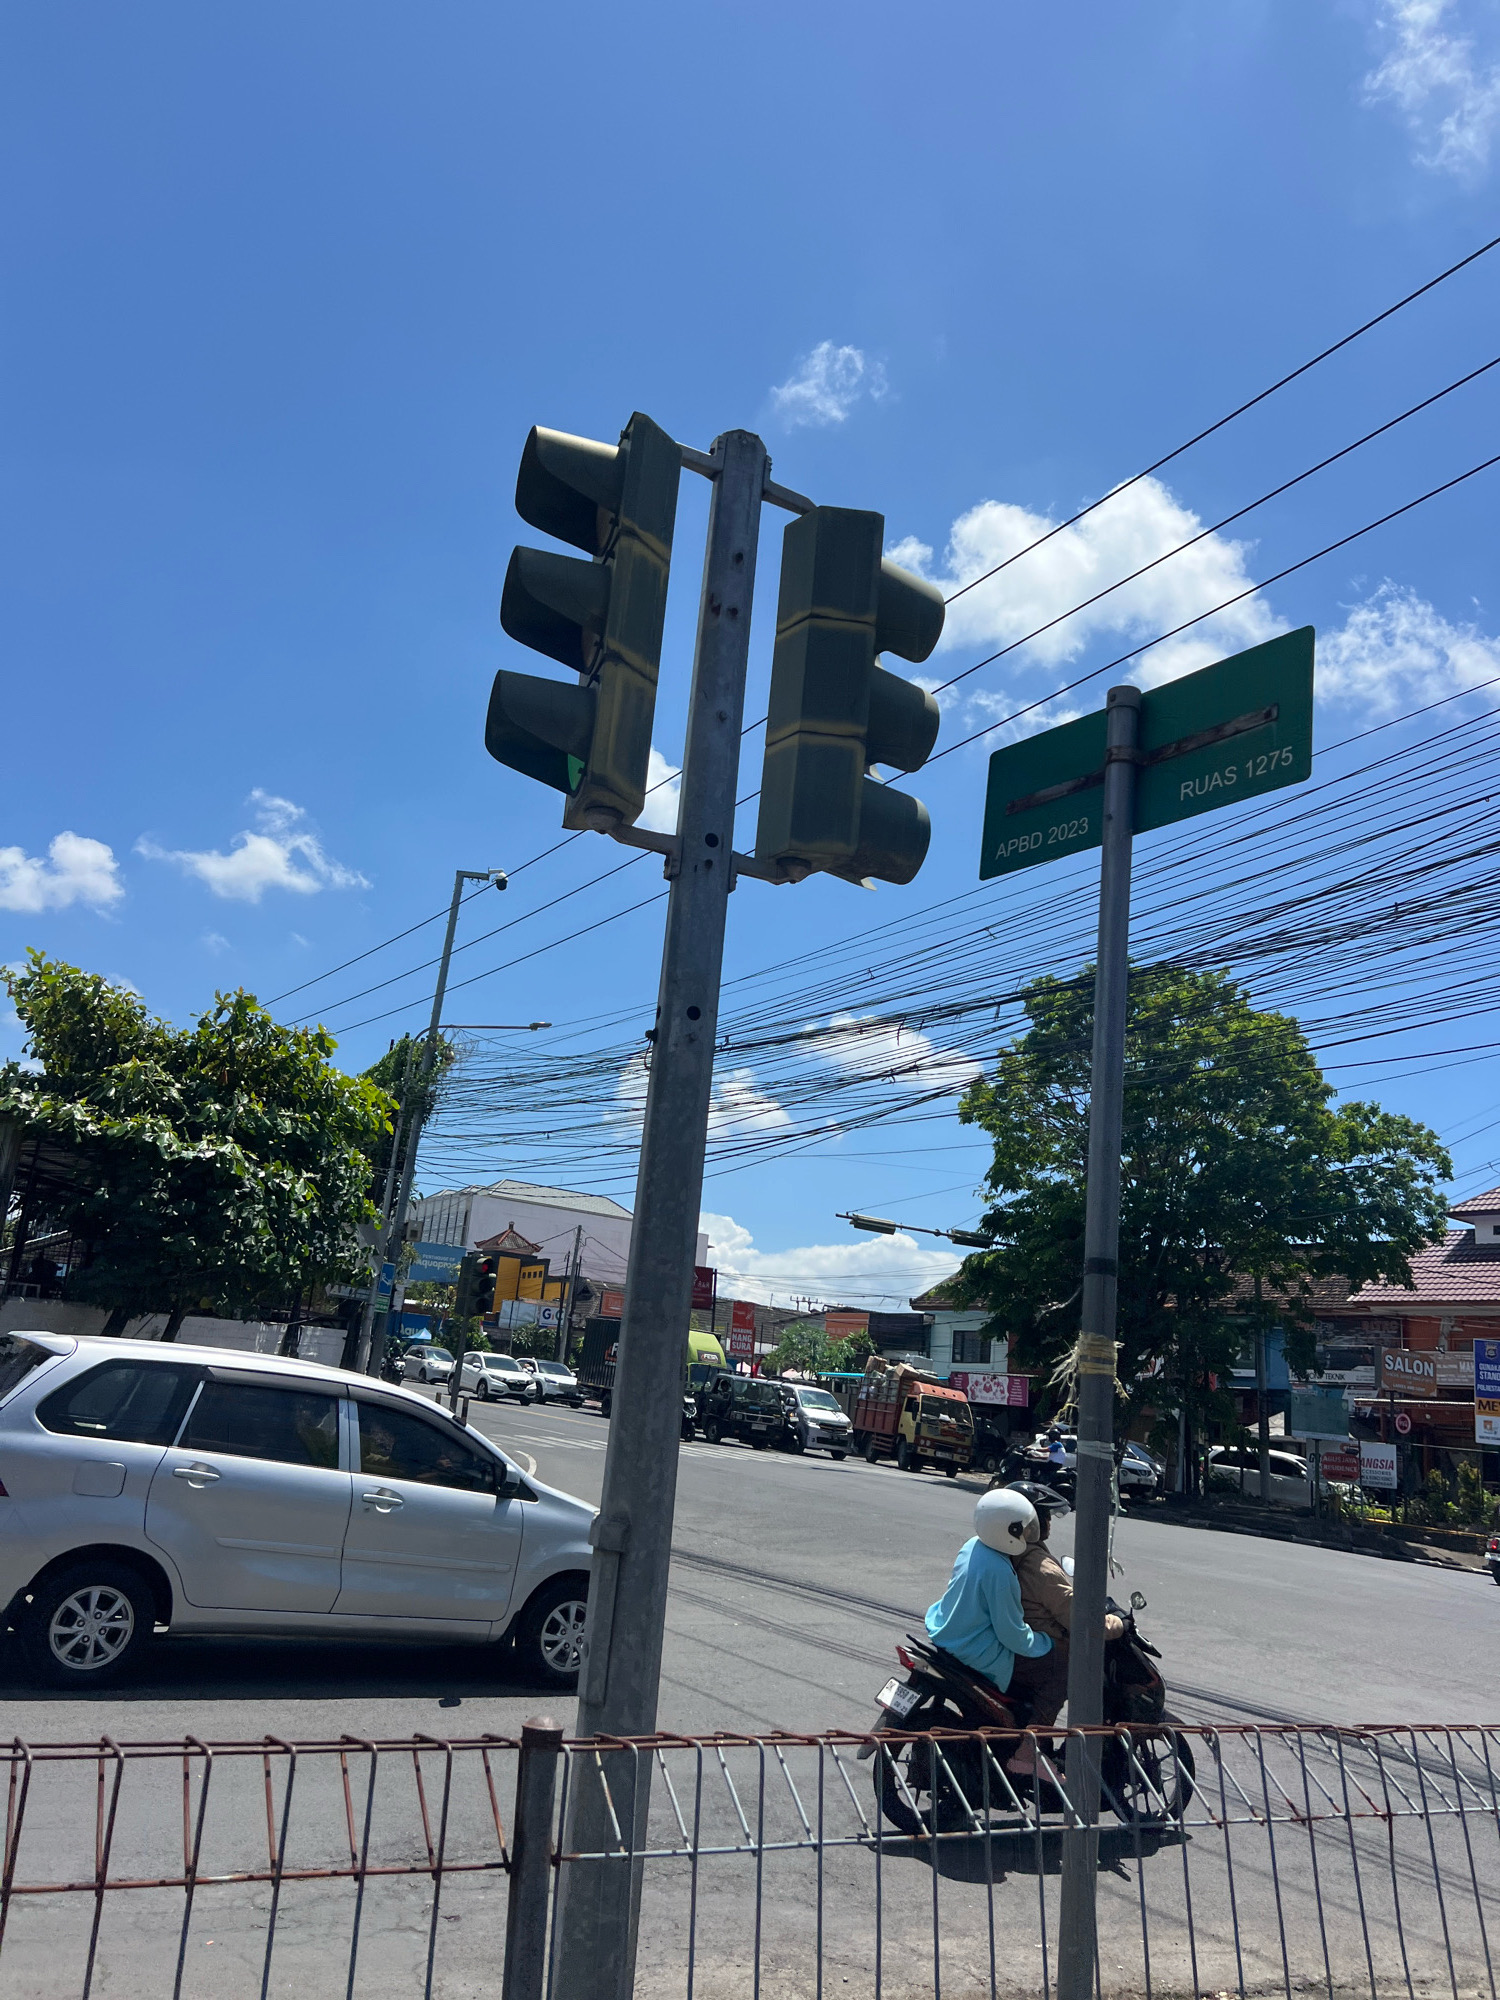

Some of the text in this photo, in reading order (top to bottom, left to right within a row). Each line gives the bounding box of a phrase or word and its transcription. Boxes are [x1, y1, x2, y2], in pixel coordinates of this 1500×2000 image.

[1180, 746, 1293, 801] RUAS 1275
[995, 817, 1090, 861] APBD 2023
[732, 1341, 752, 1351] SURA
[1384, 1354, 1434, 1377] SALON
